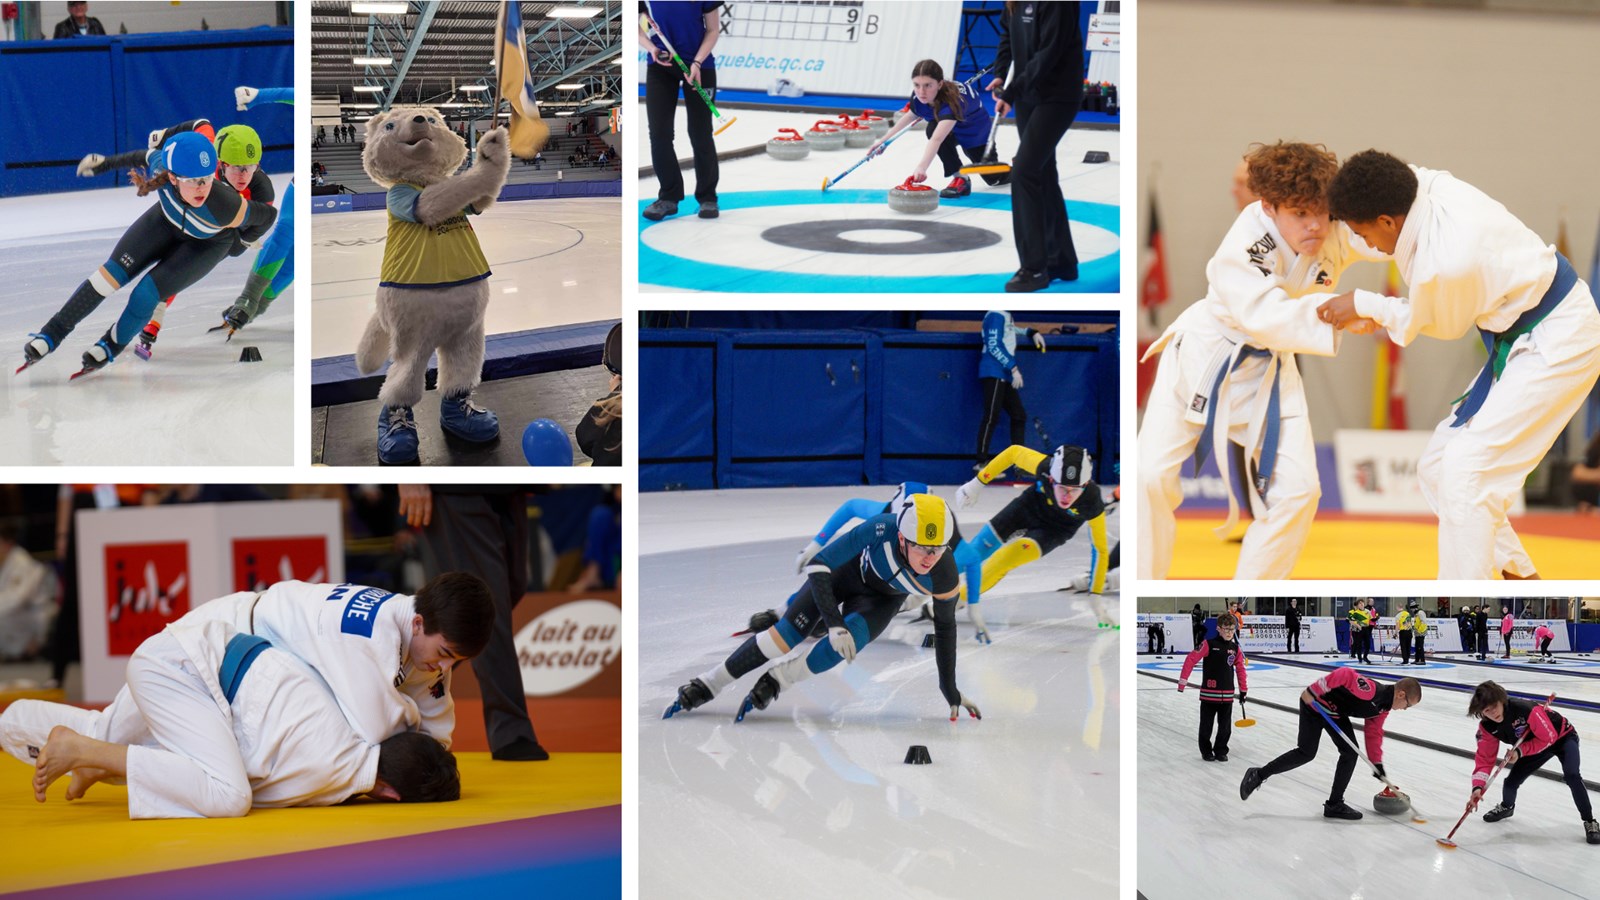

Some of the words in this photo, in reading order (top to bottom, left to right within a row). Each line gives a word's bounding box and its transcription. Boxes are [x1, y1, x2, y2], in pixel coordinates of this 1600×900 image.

[848, 9, 859, 23] 9
[865, 15, 879, 35] B
[846, 26, 855, 40] 1
[164, 141, 177, 171] 1
[531, 619, 578, 644] lait
[582, 624, 617, 641] au
[518, 644, 613, 669] hocolat
